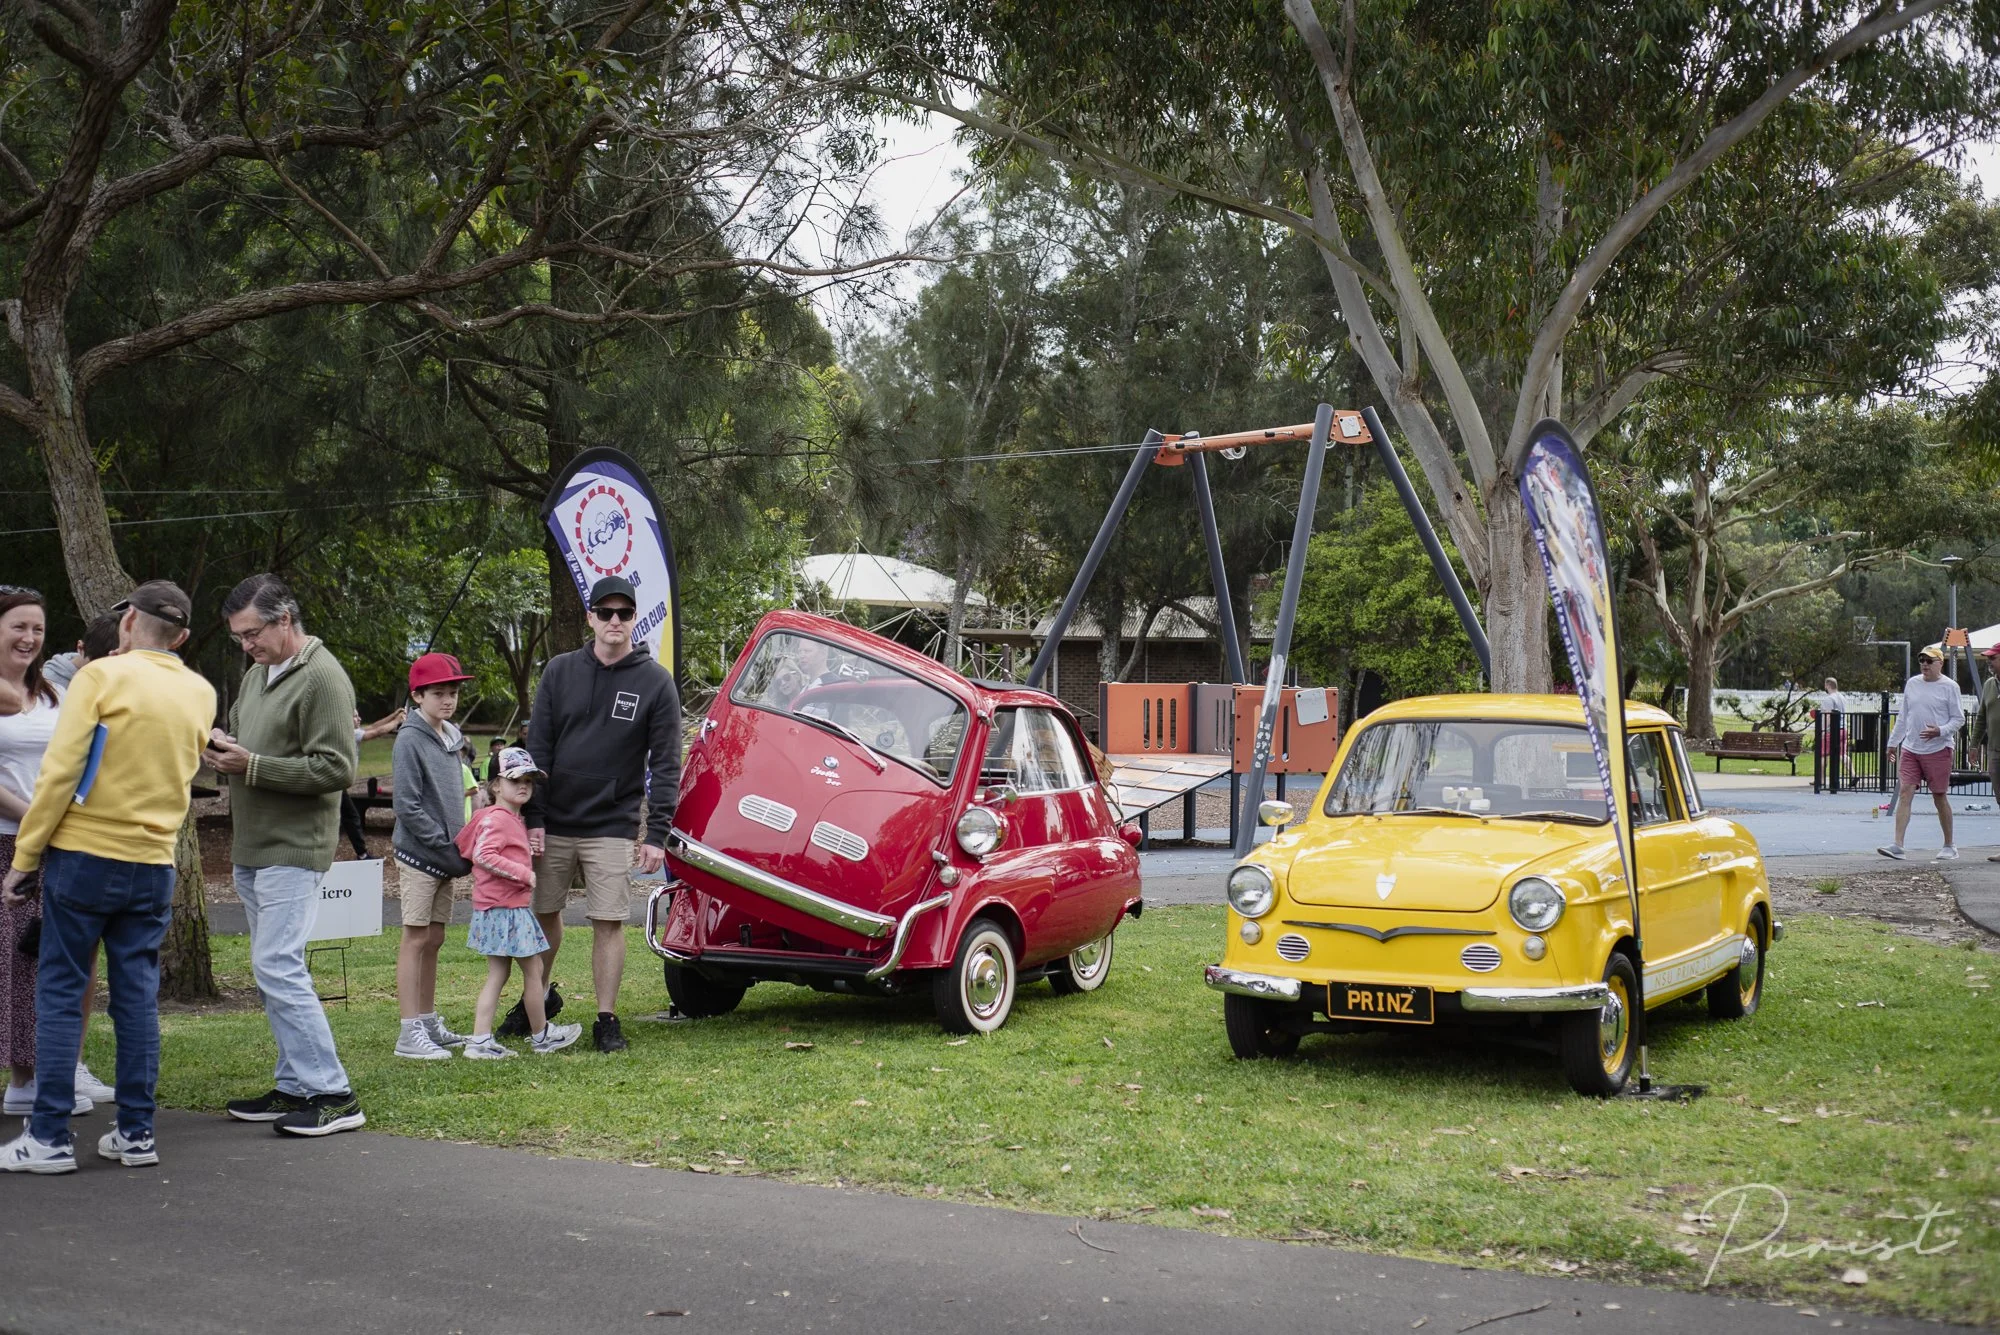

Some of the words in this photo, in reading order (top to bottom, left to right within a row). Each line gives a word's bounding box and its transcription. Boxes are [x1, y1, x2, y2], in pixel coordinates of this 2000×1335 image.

[648, 601, 667, 627] CLUB
[320, 886, 352, 899] icro
[1656, 969, 1672, 987] NSU
[1677, 961, 1700, 977] PRINZ
[1347, 990, 1414, 1014] PRINZ
